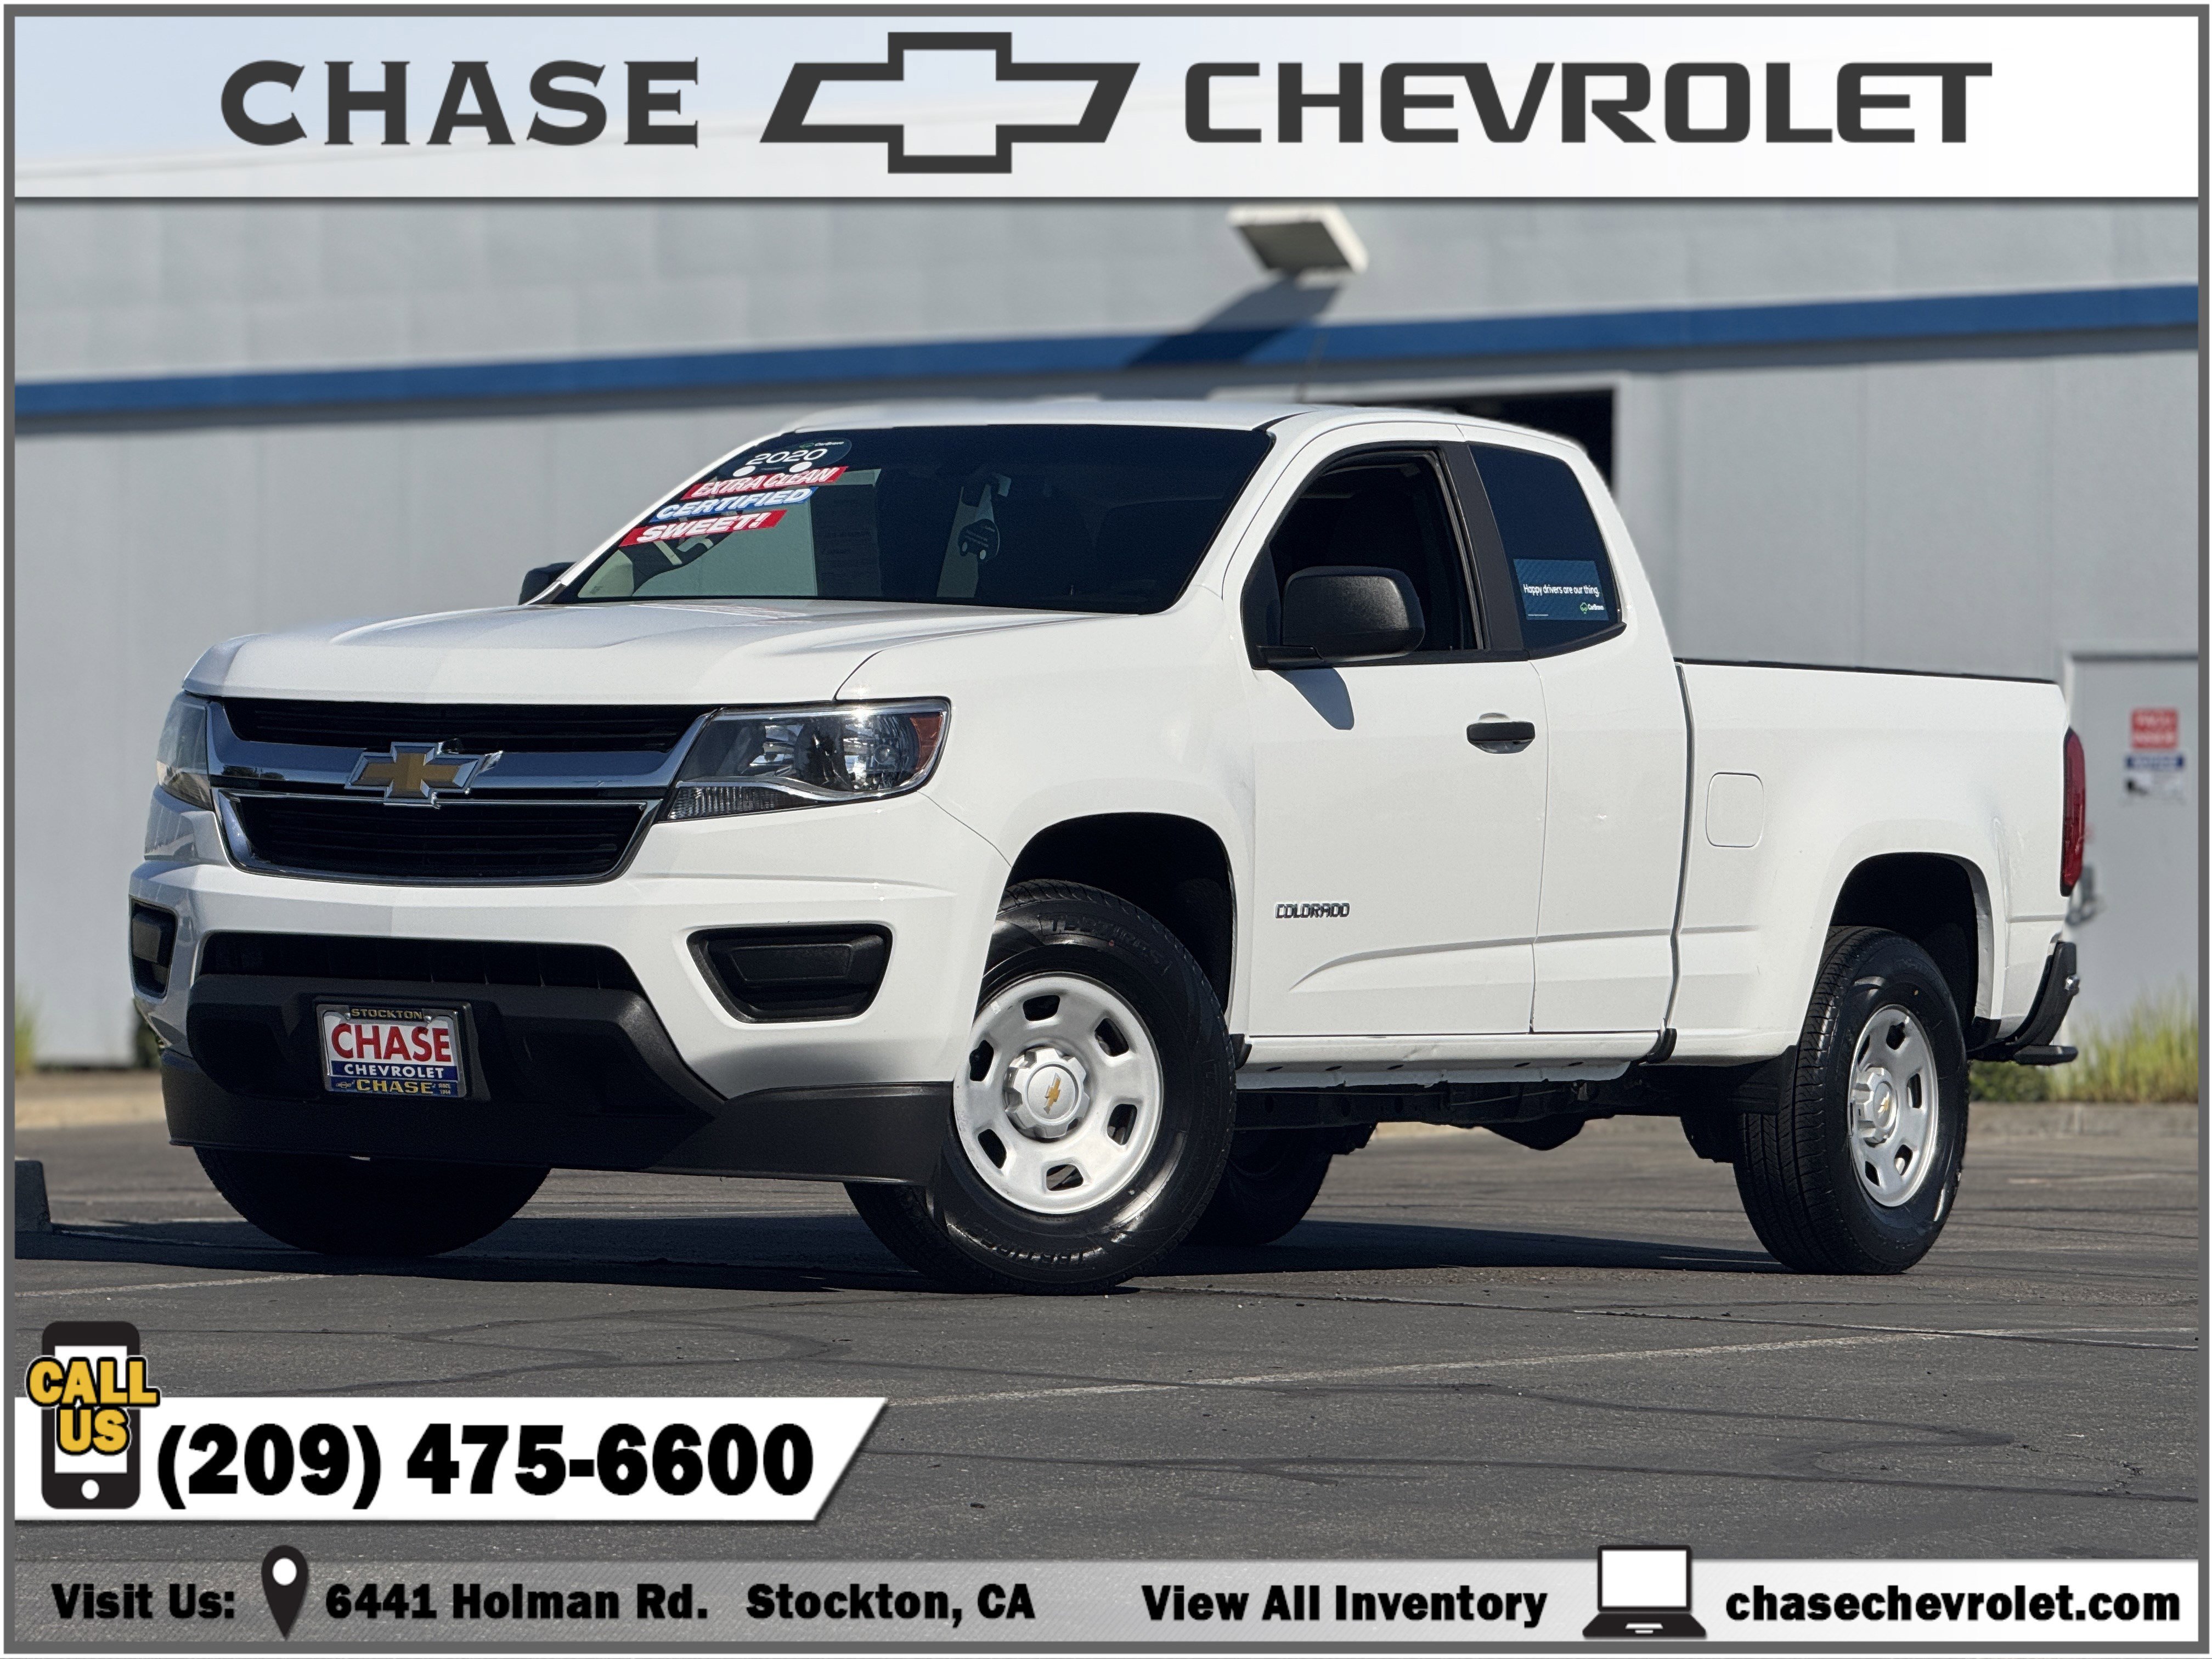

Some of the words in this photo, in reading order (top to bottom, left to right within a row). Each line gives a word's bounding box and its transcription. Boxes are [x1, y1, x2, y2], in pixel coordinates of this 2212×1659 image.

[745, 448, 828, 465] 2020
[691, 475, 763, 498] EXTRA
[763, 466, 840, 489] CLEAN
[656, 488, 813, 520] CERTIFIED
[636, 512, 772, 543] SWEET!
[1522, 583, 1542, 596] Happy
[1543, 584, 1563, 594] drivers
[1563, 586, 1573, 594] are
[1573, 586, 1583, 594] our
[1583, 584, 1600, 598] thing.
[1274, 902, 1350, 919] COLORADO
[351, 1008, 422, 1020] STOCKTON
[331, 1023, 452, 1063] CHASE
[344, 1064, 444, 1079] CHEVROLET
[357, 1079, 434, 1094] CHASE
